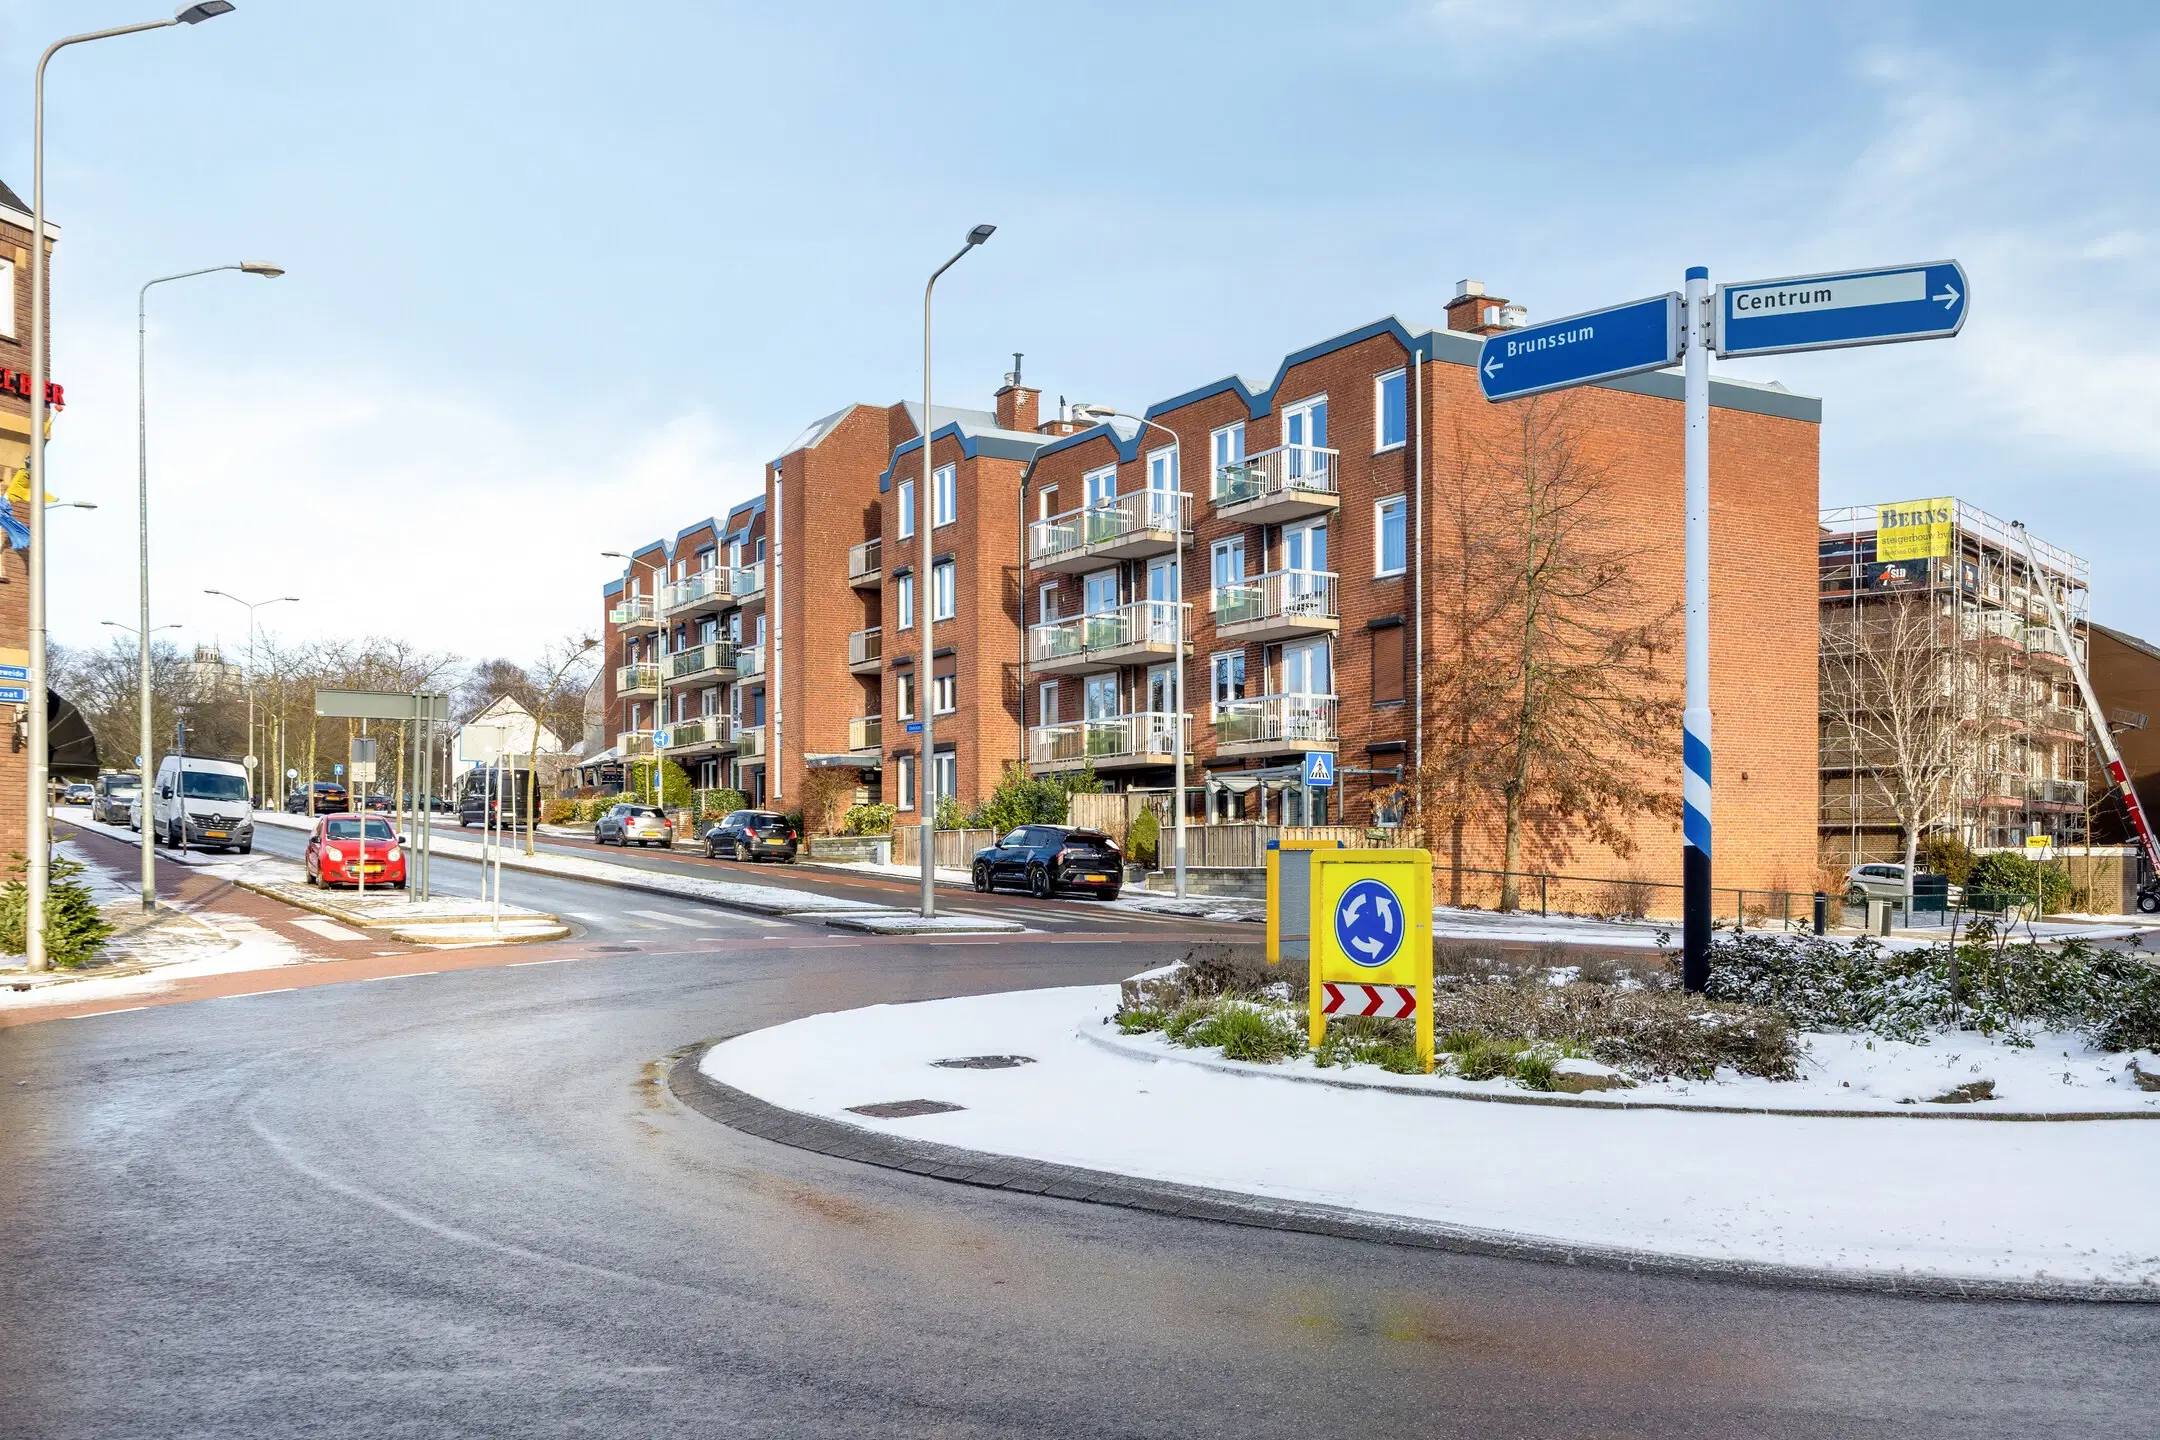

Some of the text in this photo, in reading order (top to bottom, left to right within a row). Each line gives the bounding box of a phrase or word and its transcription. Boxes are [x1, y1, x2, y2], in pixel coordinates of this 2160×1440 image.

[1736, 288, 1832, 311] Centrum
[1507, 326, 1594, 357] Brunssum
[21, 373, 65, 405] BER
